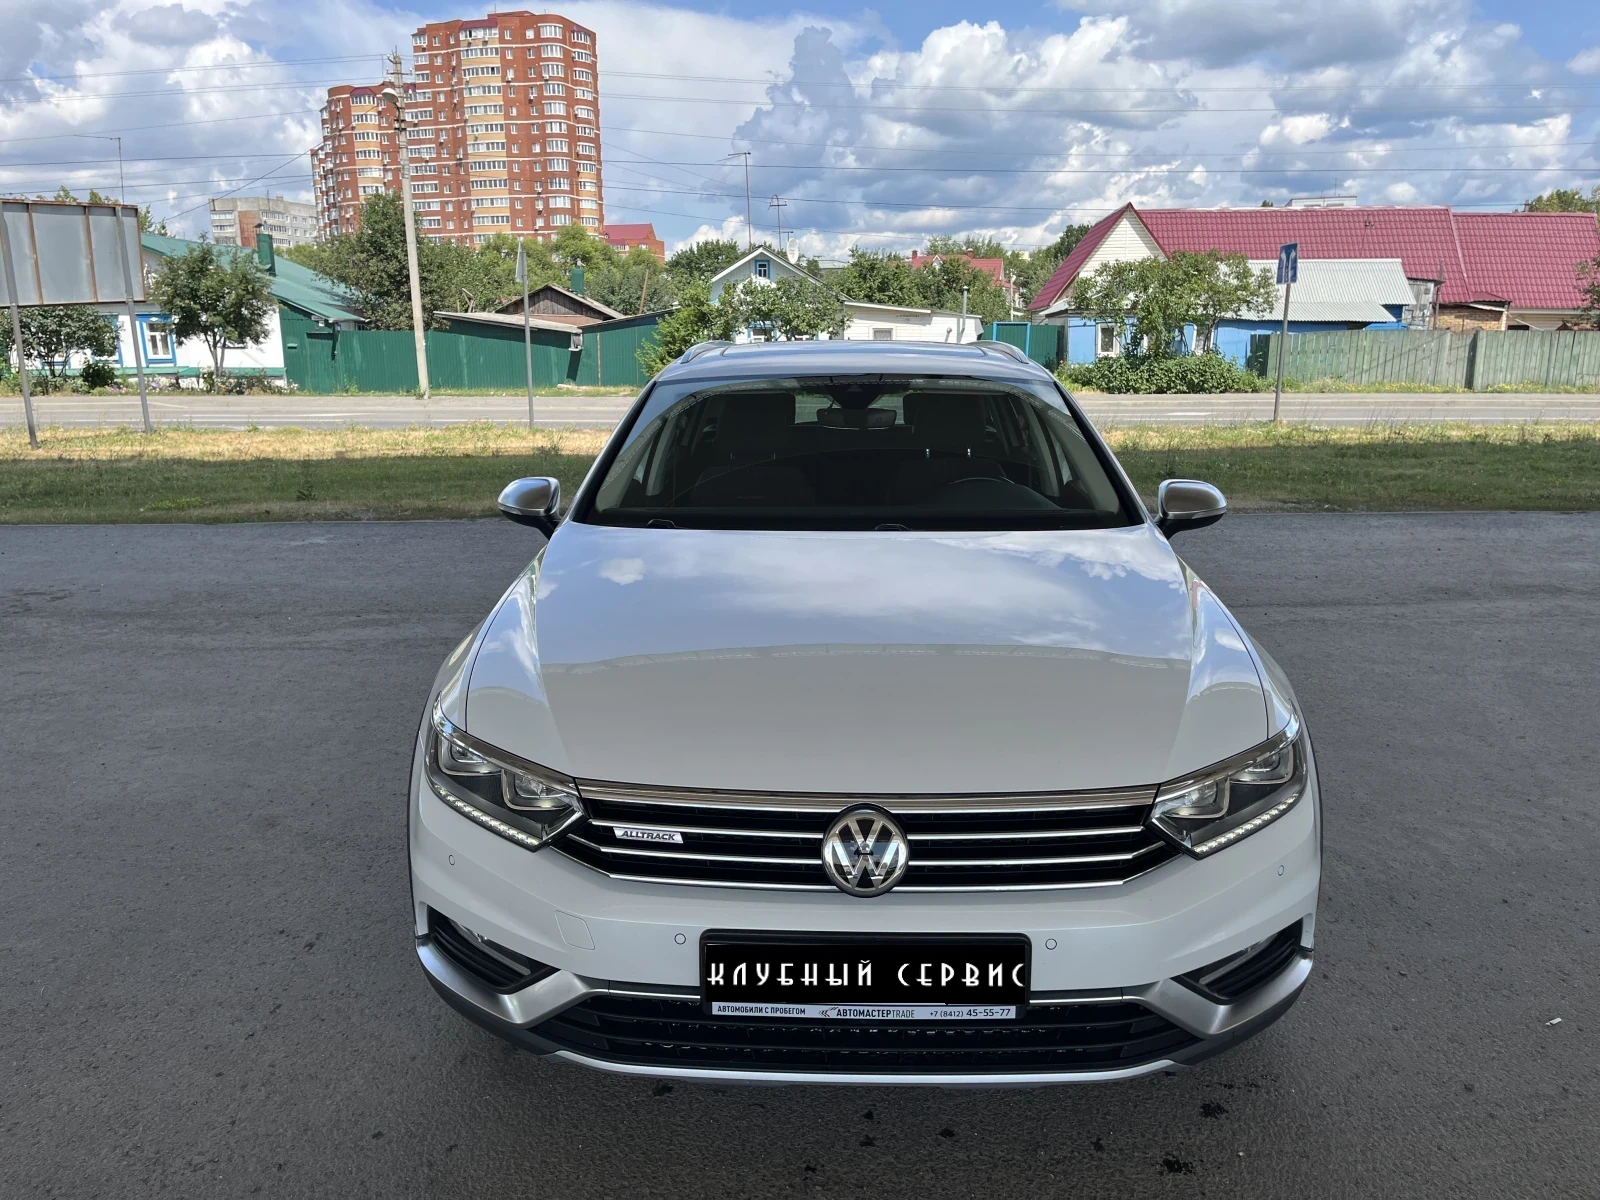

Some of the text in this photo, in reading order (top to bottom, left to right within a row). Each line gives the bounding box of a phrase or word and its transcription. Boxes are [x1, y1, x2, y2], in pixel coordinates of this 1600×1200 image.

[621, 831, 675, 841] ALLTRACK
[717, 1006, 806, 1015] АВТОМОБИЛИ С ПРОБЕГОМ
[940, 1010, 964, 1018] (8412)
[966, 1008, 1011, 1017] 45-55-77
